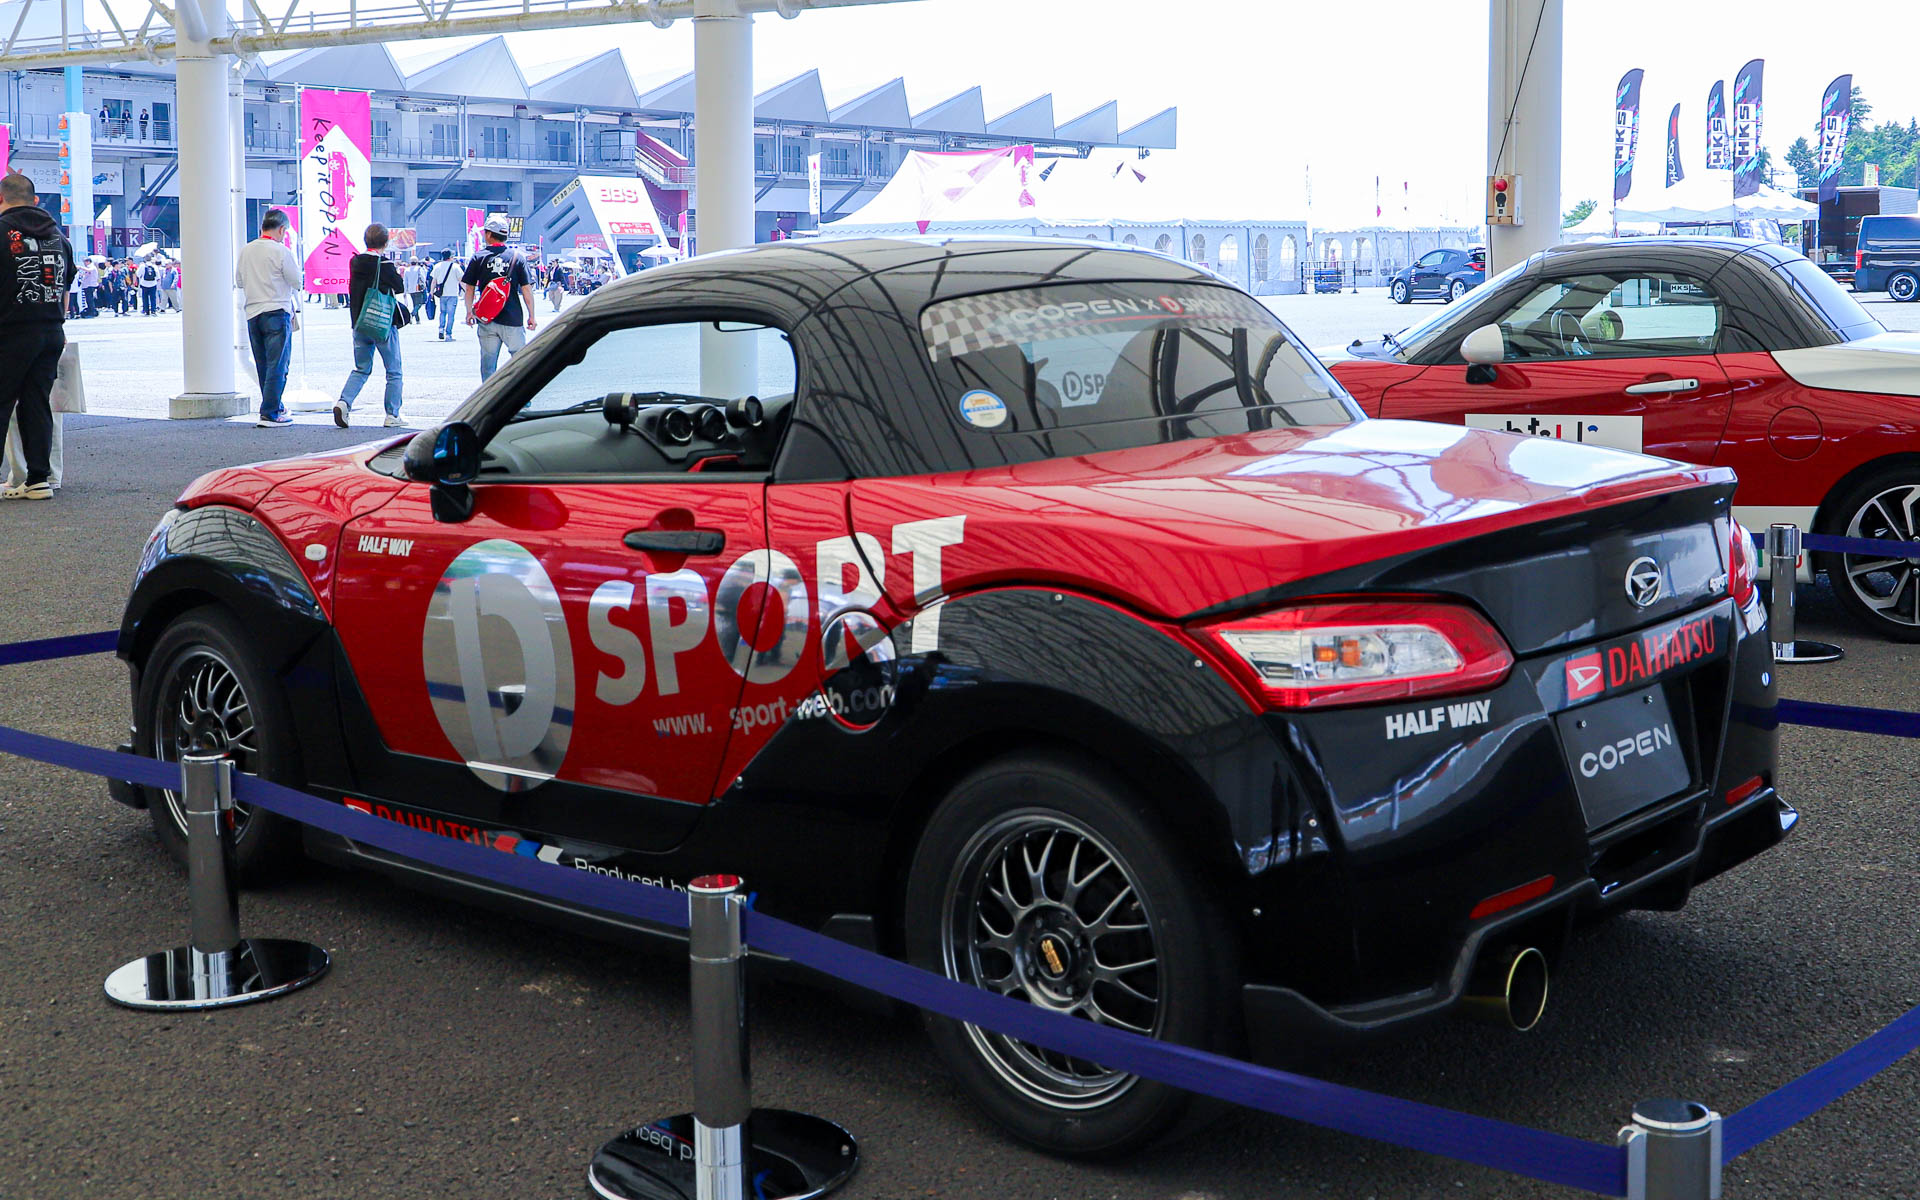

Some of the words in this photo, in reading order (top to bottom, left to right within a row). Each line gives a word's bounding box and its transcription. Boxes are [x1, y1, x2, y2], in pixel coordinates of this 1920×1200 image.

[310, 117, 332, 166] Keep
[1615, 111, 1627, 160] HKS
[1712, 118, 1723, 164] HKS
[1738, 105, 1750, 157] HKS
[1824, 117, 1837, 163] HKS
[317, 172, 332, 186] it
[600, 187, 639, 204] BBS
[129, 234, 140, 246] K
[1010, 298, 1140, 323] COPEN
[357, 535, 388, 554] HALF
[388, 538, 415, 557] WAY
[587, 514, 967, 706] SPORT
[1608, 616, 1716, 688] DAIHATSU
[652, 712, 713, 738] www.
[1385, 706, 1446, 740] HALF
[1447, 699, 1491, 729] WAY
[1580, 723, 1672, 778] COPEN
